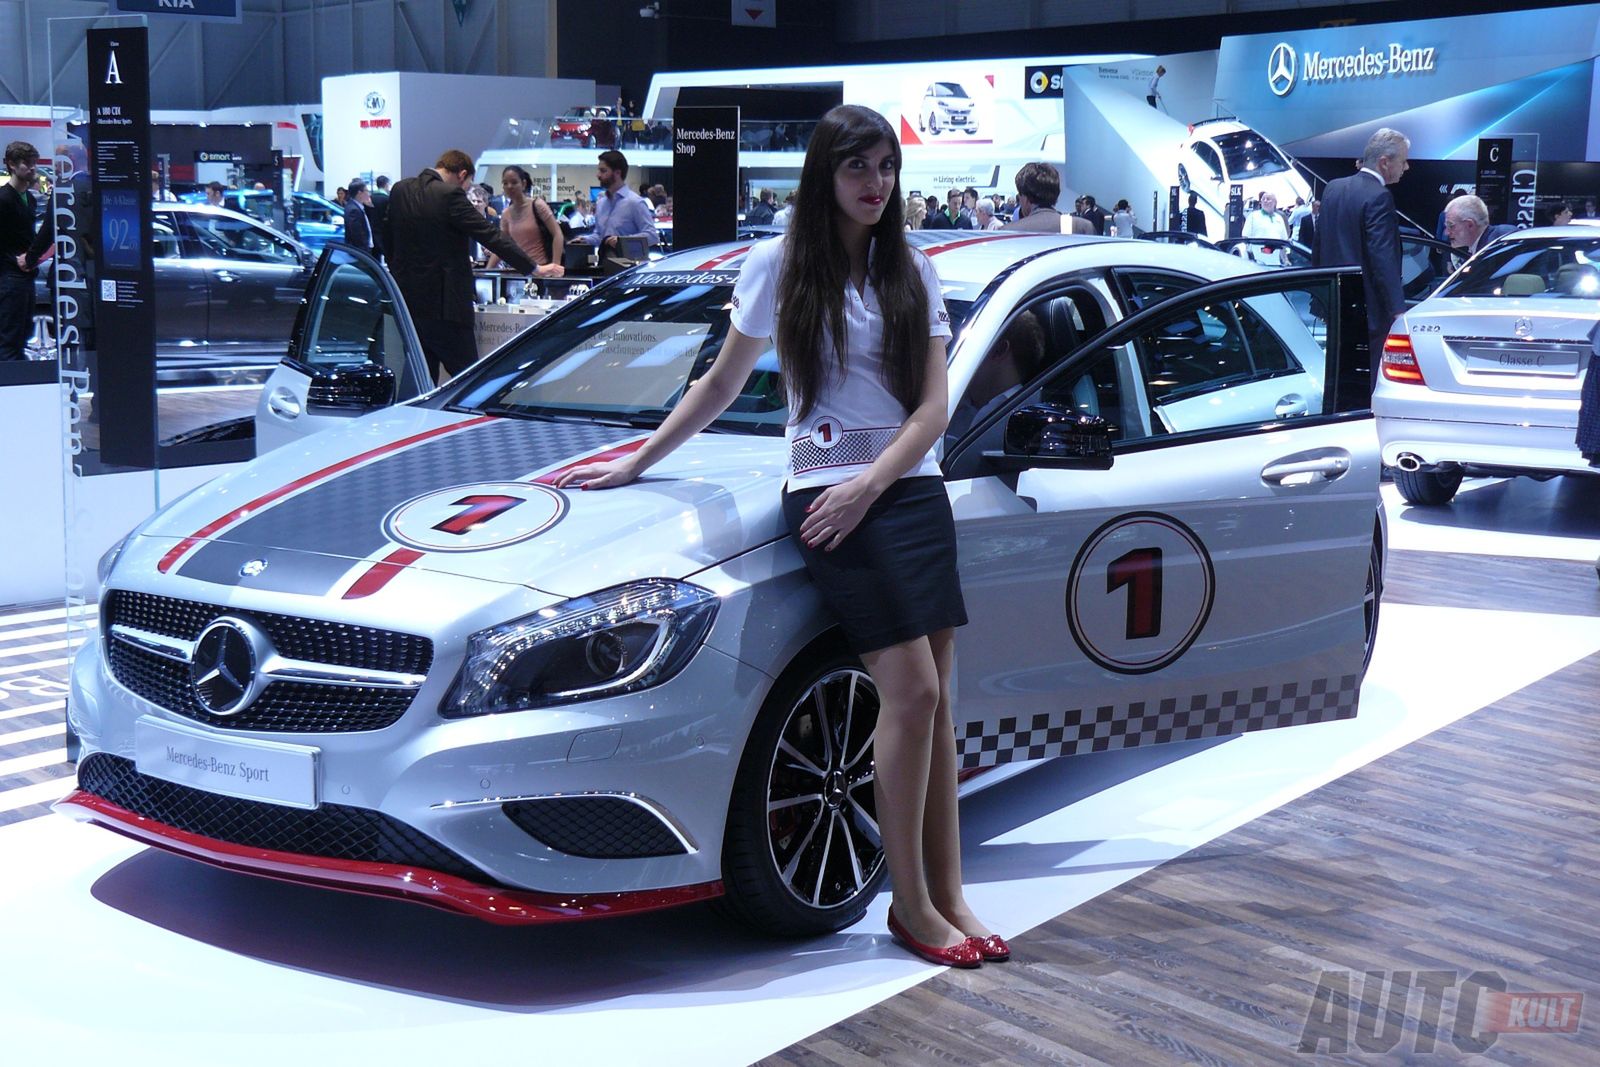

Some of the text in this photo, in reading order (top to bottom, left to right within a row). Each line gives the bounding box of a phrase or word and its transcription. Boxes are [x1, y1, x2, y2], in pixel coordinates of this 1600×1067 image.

[105, 50, 124, 84] A
[1302, 43, 1435, 81] Mercedes-Benz
[676, 127, 736, 140] Mercedes-Benz
[676, 142, 696, 157] Shop
[1489, 147, 1500, 162] C
[109, 218, 130, 251] 92
[53, 104, 90, 481] Mercedes-Ben
[1499, 353, 1545, 367] Classe C
[818, 423, 832, 443] 1
[430, 494, 527, 535] 1
[1106, 547, 1162, 640] 1
[166, 746, 270, 783] Mercedes-Benz Sport
